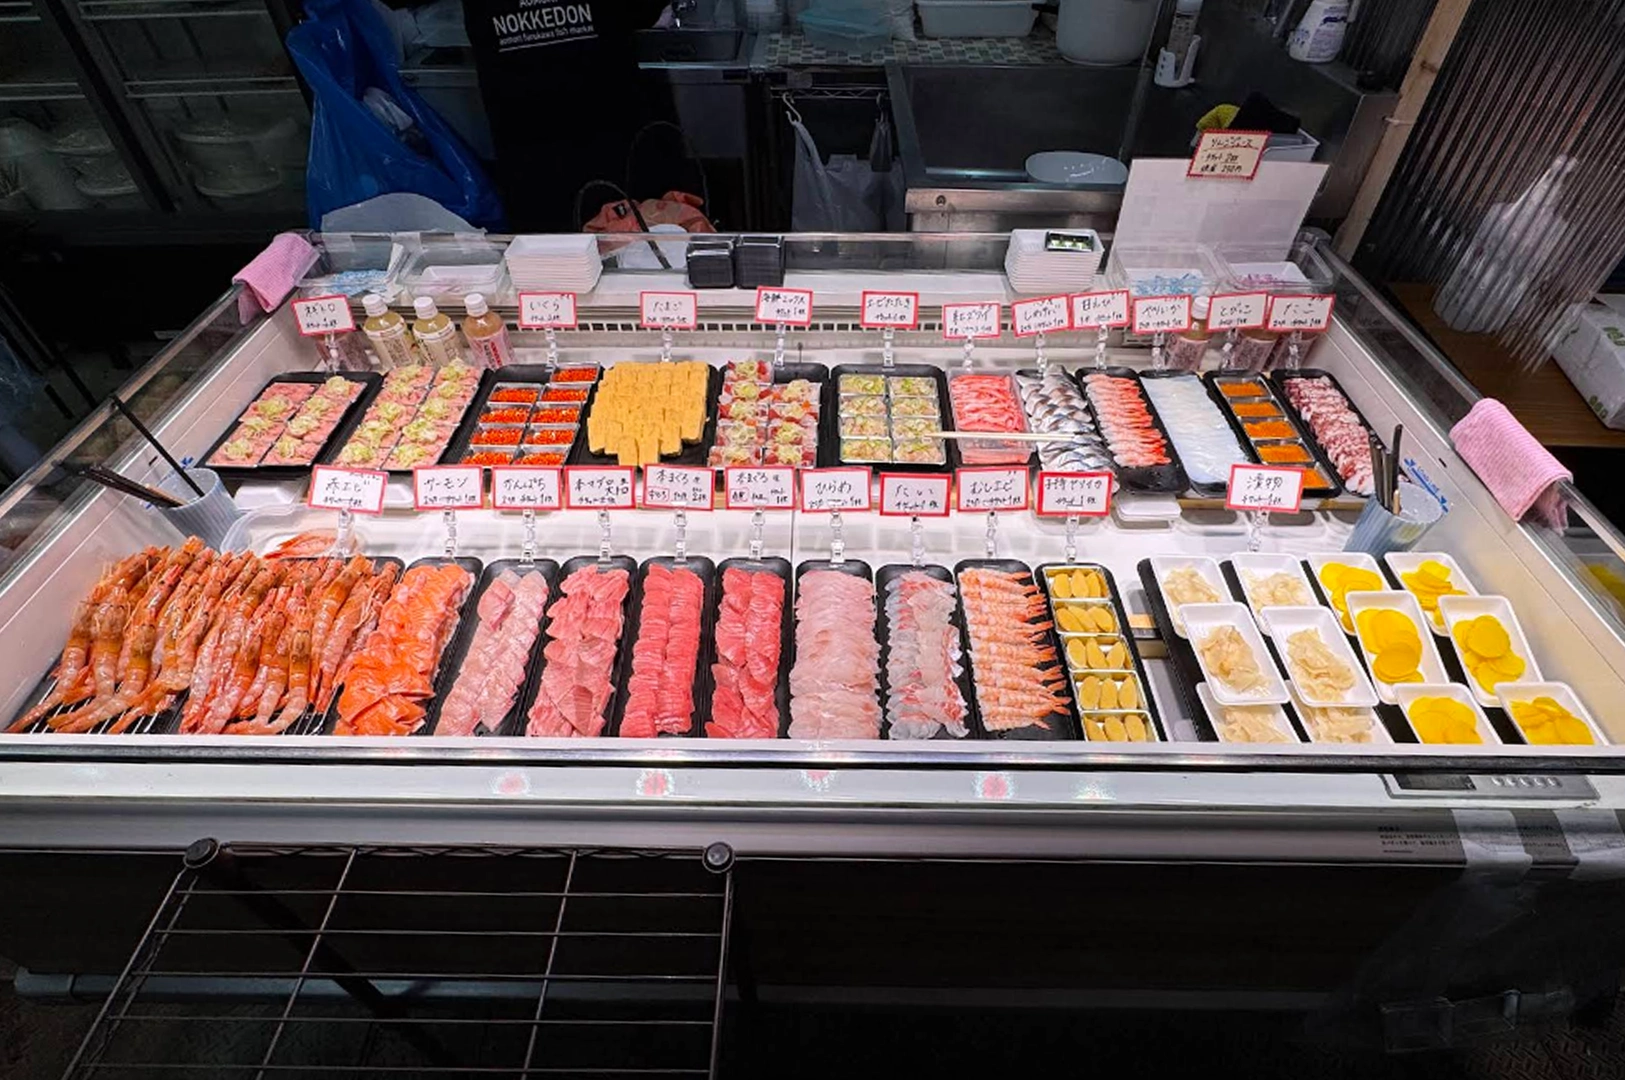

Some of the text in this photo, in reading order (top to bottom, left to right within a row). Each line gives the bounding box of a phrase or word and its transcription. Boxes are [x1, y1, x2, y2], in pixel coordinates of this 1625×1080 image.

[492, 3, 593, 35] NOKKEDON
[529, 300, 561, 312] いくら
[652, 301, 683, 313] たまご
[423, 477, 469, 491] サーモン
[814, 480, 853, 494] ひらめ
